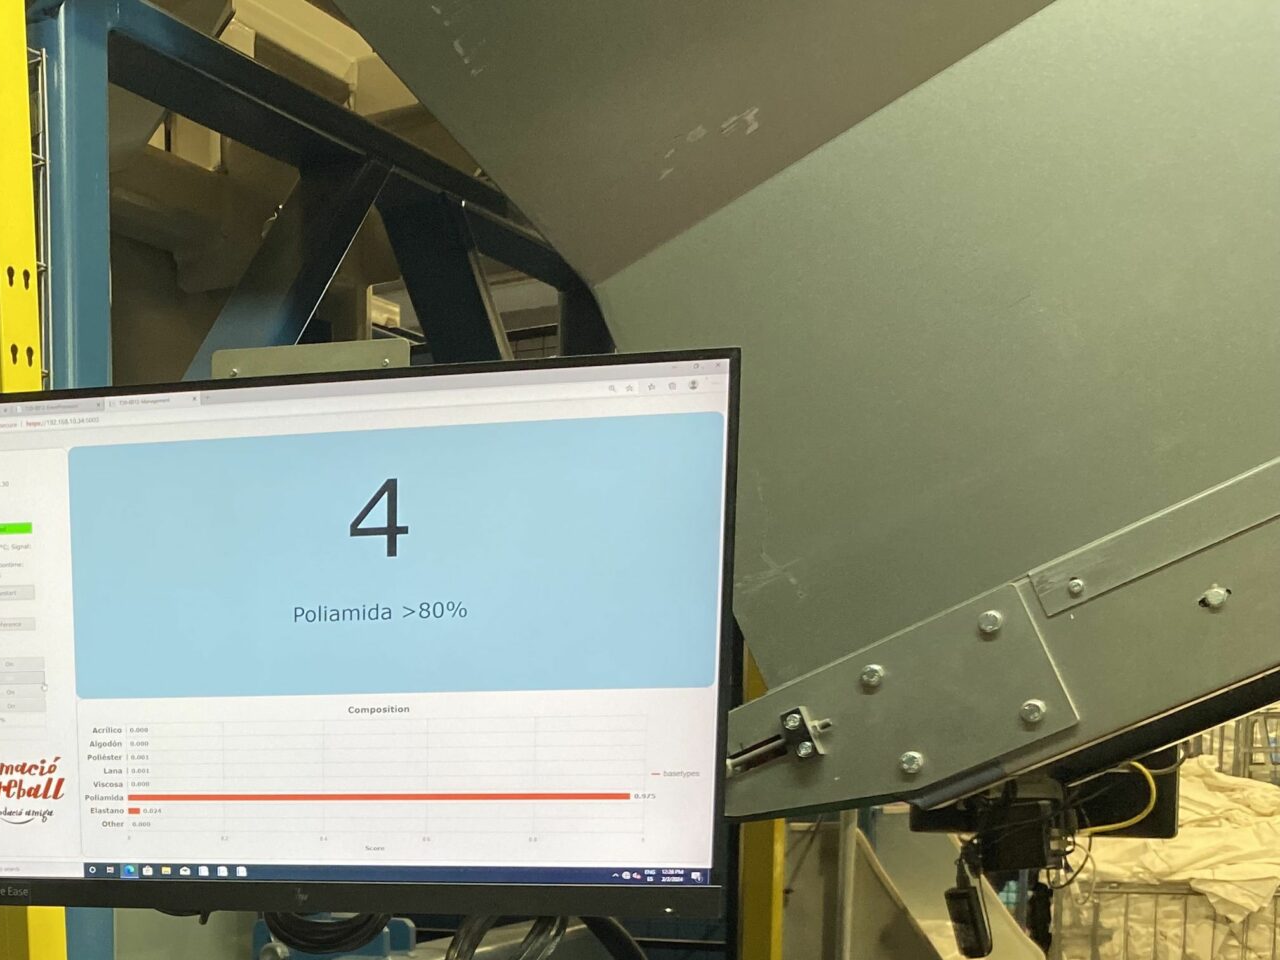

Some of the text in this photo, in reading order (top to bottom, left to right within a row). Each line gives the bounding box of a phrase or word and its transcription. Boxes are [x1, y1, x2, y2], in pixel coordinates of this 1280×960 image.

[349, 477, 409, 557] 4
[294, 600, 468, 623] Poliamida >80%
[347, 705, 410, 715] Composition
[89, 740, 123, 749] Algodón
[87, 753, 122, 761] Poliéster
[663, 769, 700, 777] basetypes
[101, 820, 124, 828] Other
[7, 887, 29, 896] Ease
